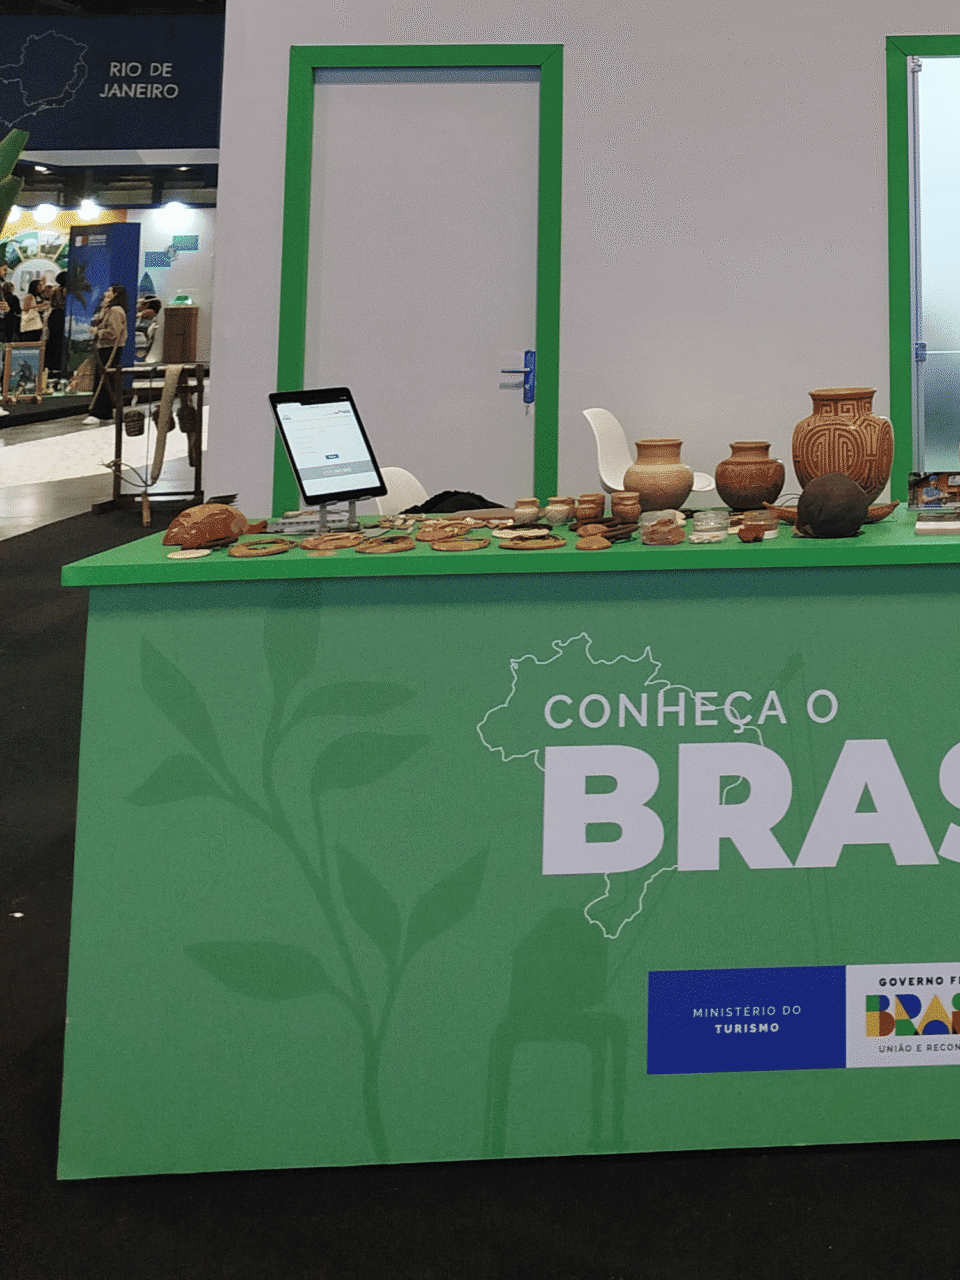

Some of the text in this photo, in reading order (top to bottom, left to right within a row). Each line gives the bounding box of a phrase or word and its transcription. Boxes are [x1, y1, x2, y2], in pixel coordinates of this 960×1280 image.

[109, 61, 173, 78] RIO DE
[99, 83, 179, 99] JANEIRO
[543, 688, 839, 734] CONHEÇA O
[878, 976, 944, 987] GOVERNO
[692, 1003, 801, 1018] MINISTÉRIO DO
[714, 1022, 780, 1034] TURISMO
[877, 1042, 912, 1054] UNIÃO
[916, 1043, 922, 1052] E
